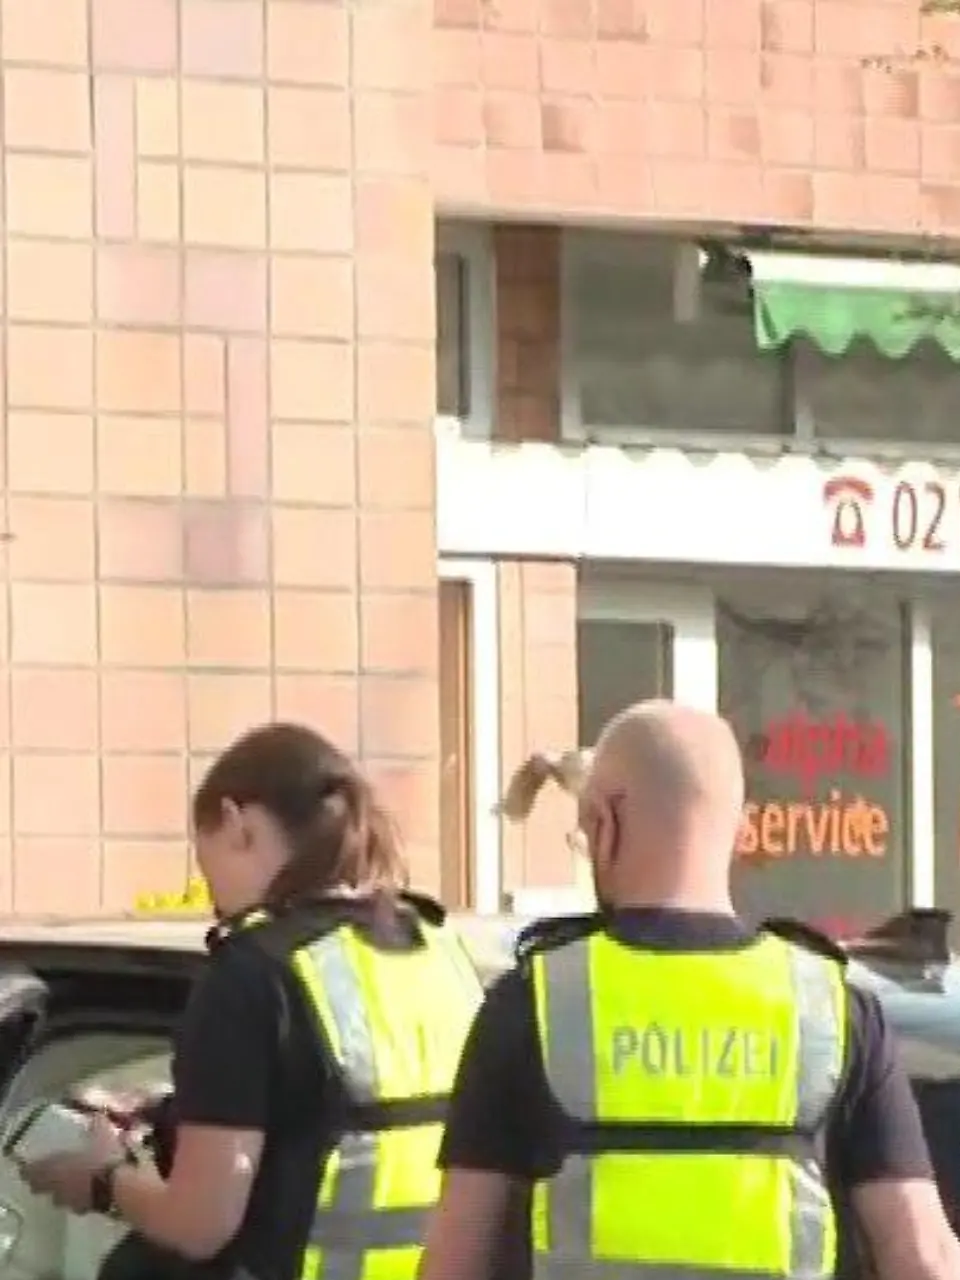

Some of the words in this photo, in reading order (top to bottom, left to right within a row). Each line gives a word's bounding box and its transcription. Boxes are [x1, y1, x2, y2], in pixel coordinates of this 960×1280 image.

[763, 713, 890, 794] alpha
[736, 787, 889, 858] service
[612, 1022, 778, 1078] POLIZEI
